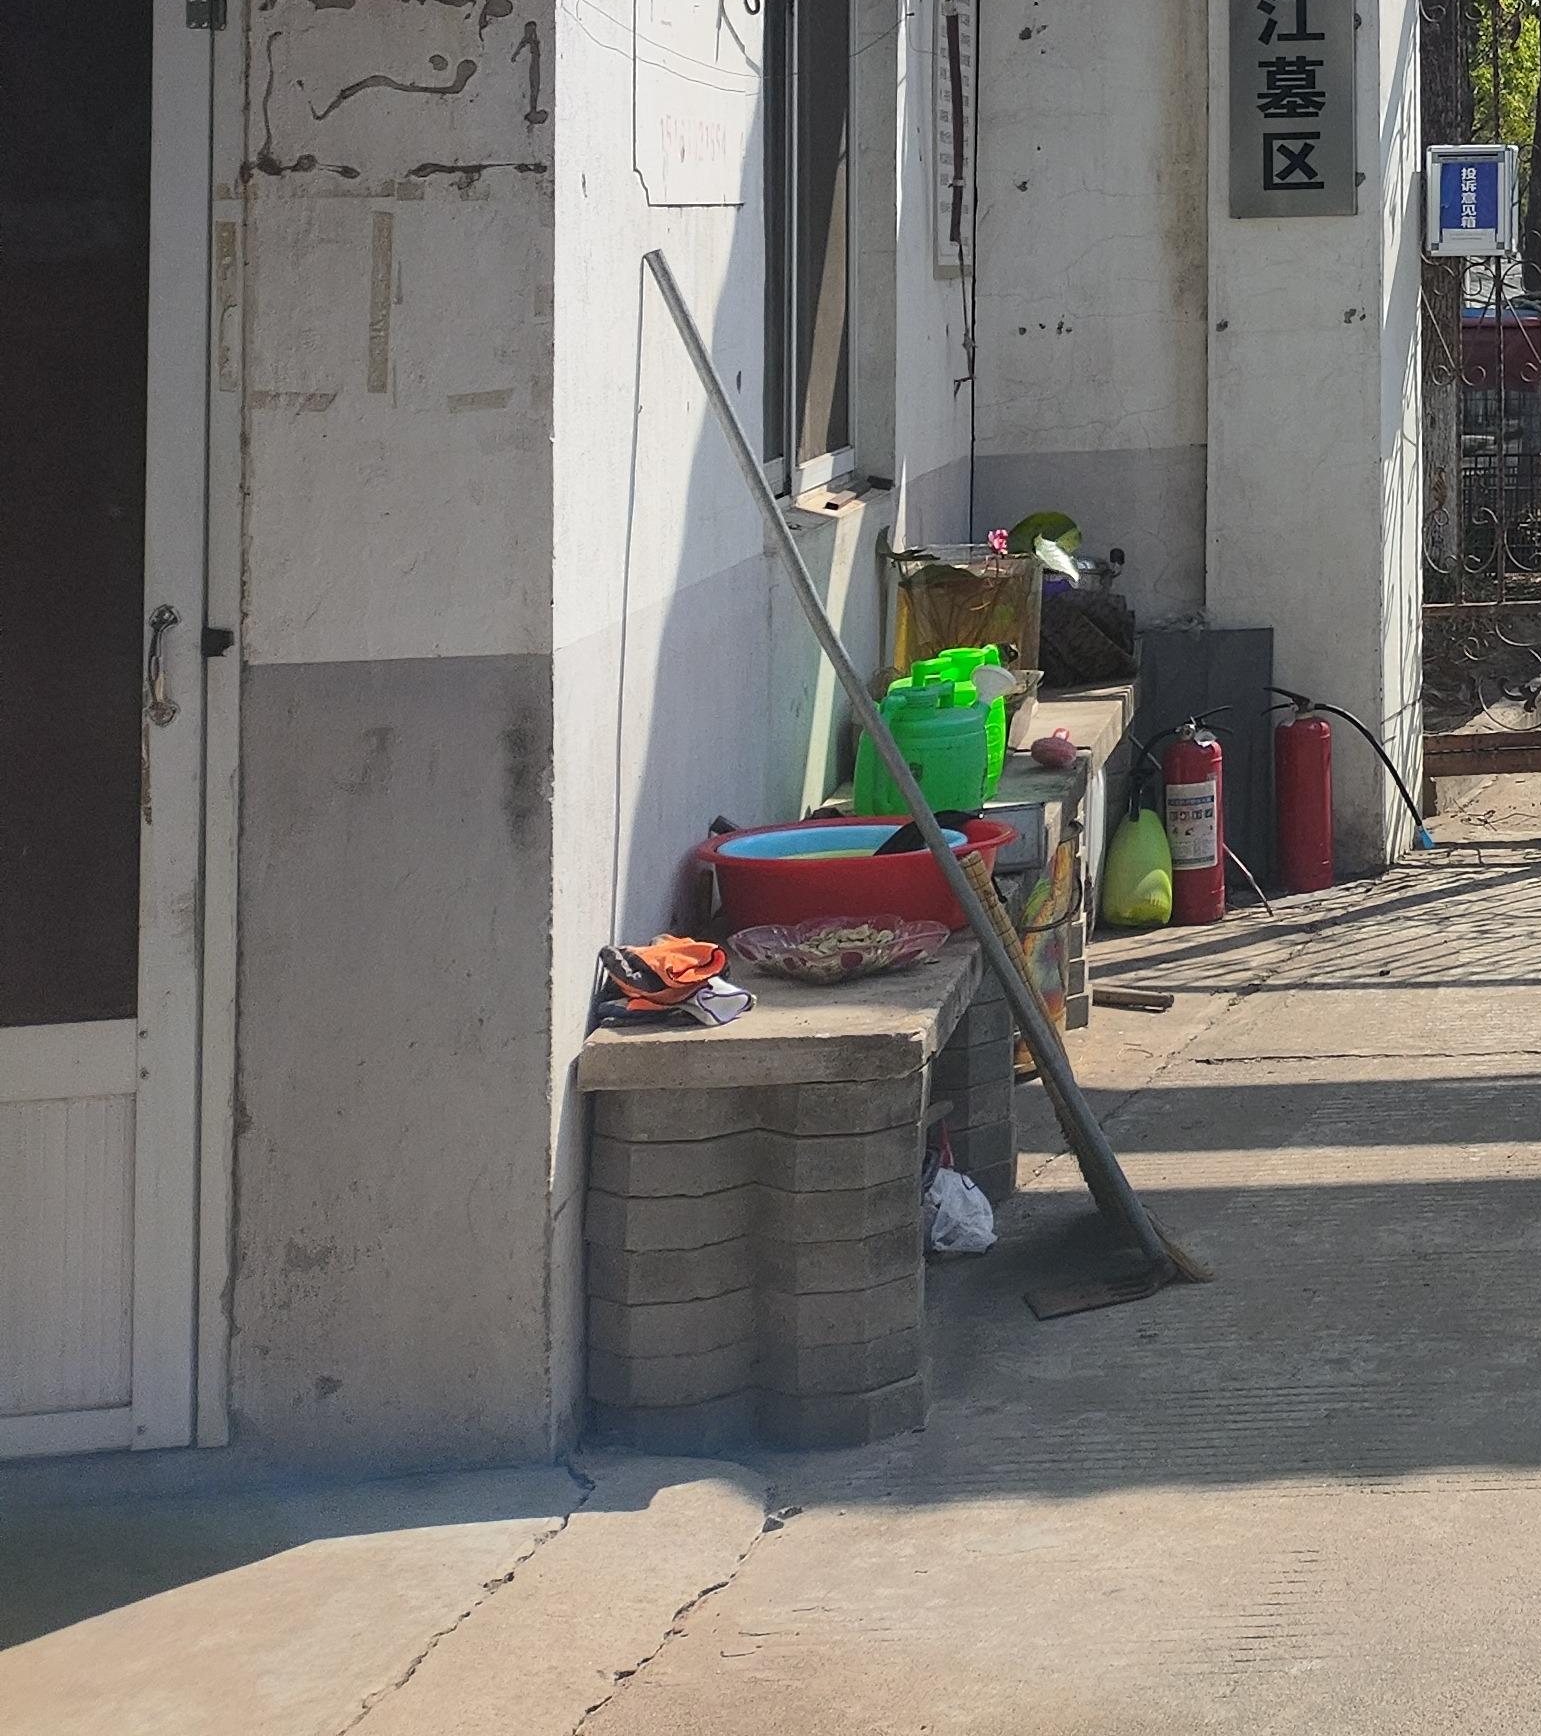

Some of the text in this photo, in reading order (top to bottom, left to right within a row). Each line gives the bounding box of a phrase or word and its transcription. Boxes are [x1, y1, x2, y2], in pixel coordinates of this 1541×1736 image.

[1461, 167, 1477, 229] 投诉意见箱
